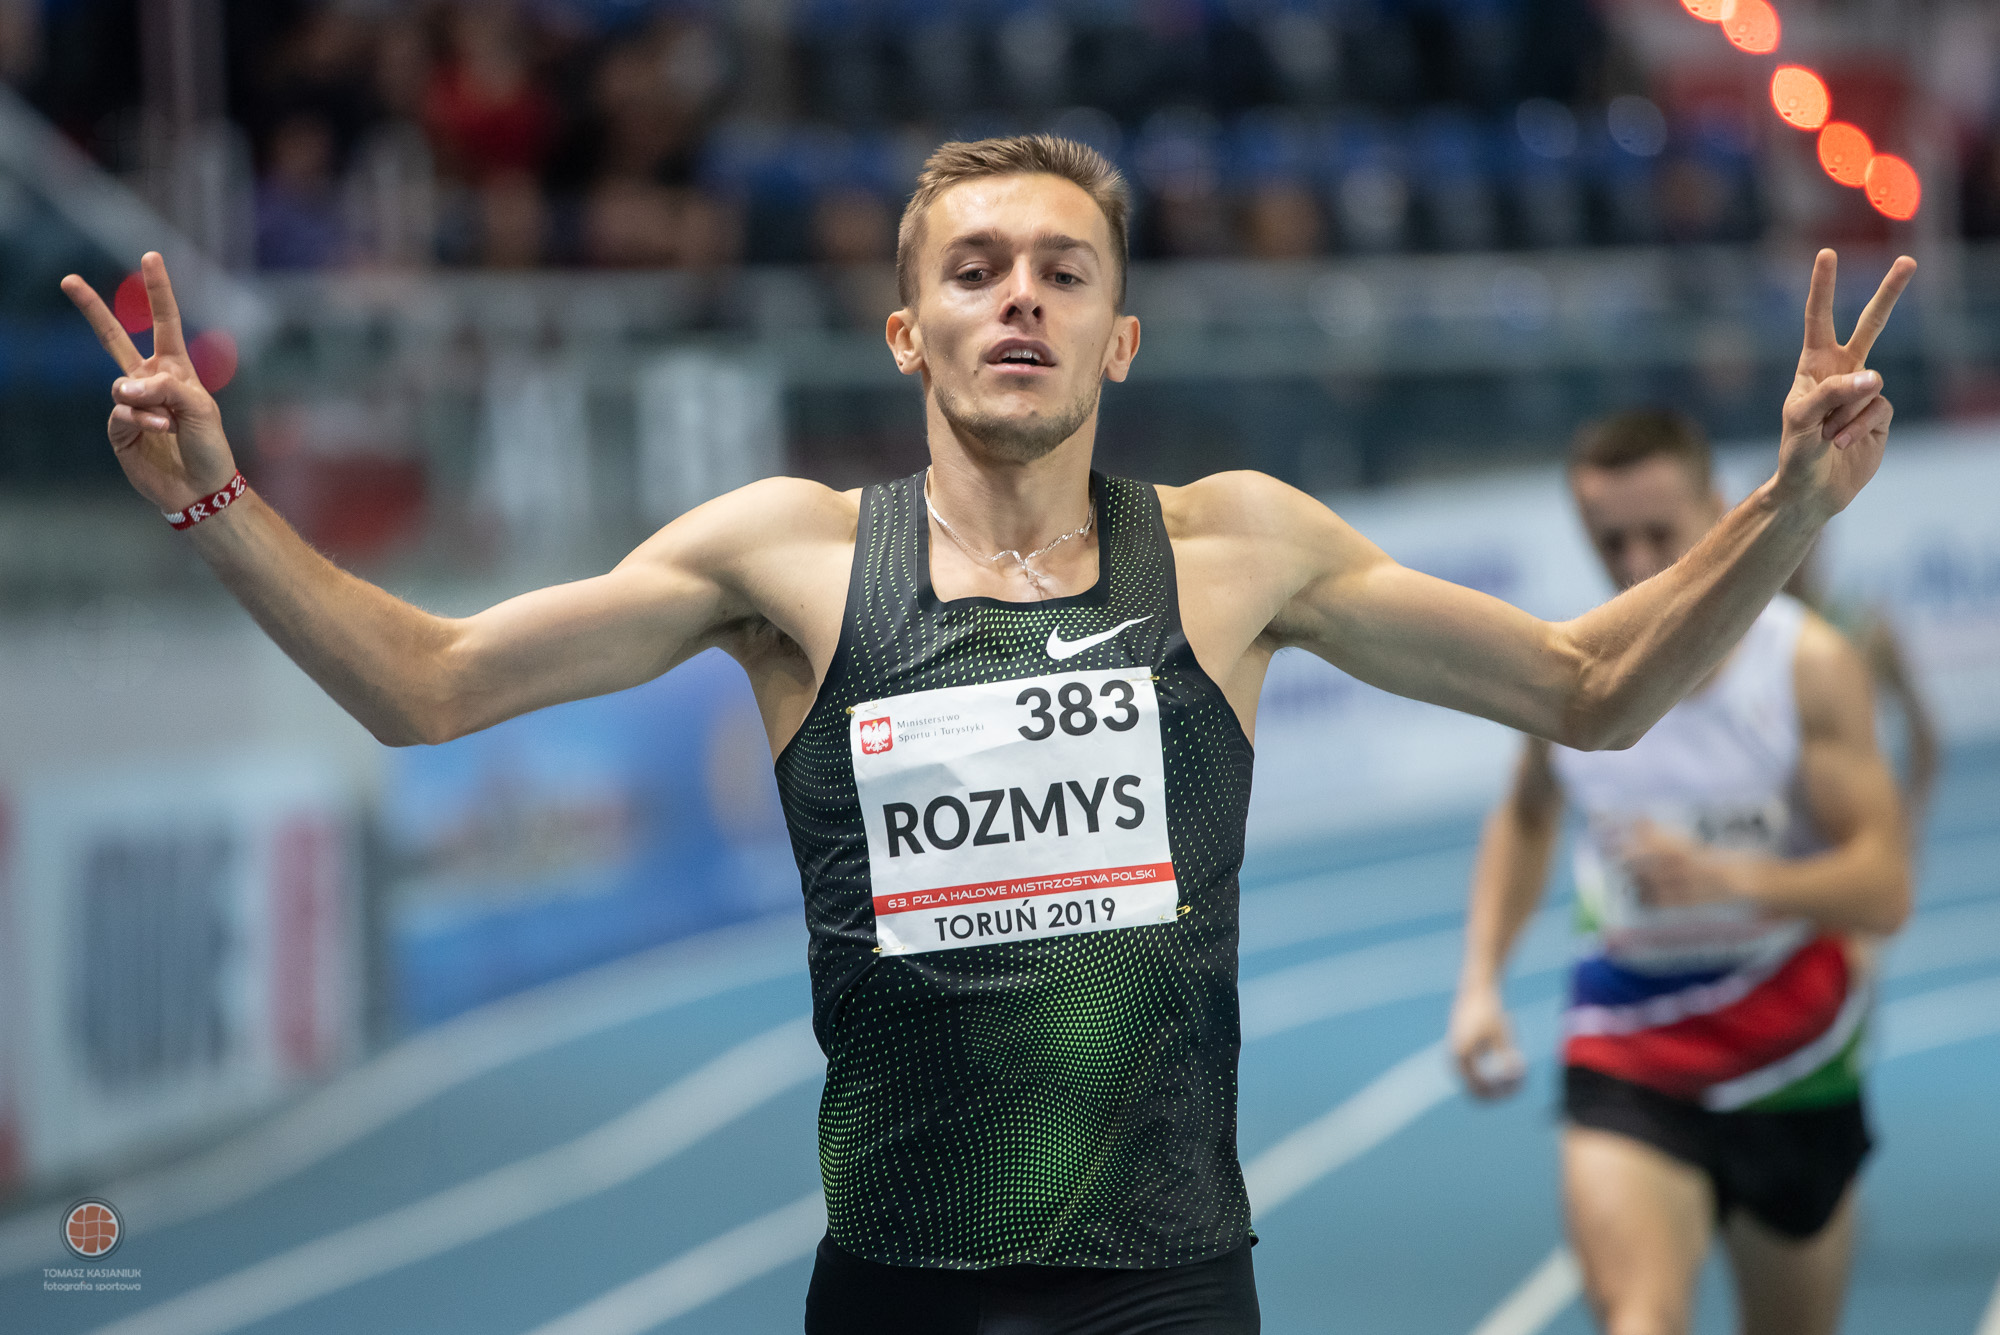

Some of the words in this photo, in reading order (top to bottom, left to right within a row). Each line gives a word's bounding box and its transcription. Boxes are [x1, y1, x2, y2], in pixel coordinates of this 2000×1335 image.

[188, 475, 246, 522] ROZ
[897, 714, 960, 729] Ministerstwo
[898, 730, 931, 742] Sportu
[941, 723, 984, 737] Turystyki
[1015, 679, 1139, 741] 383
[883, 775, 1145, 858] ROZMYS
[887, 898, 909, 909] 63.
[913, 893, 947, 906] PZLA
[950, 883, 1007, 901] HALOWE
[1010, 873, 1109, 893] MISTRZOSTWA
[1111, 869, 1156, 881] POLSKI
[934, 899, 1037, 942] TORUŃ
[1048, 897, 1116, 929] 2019
